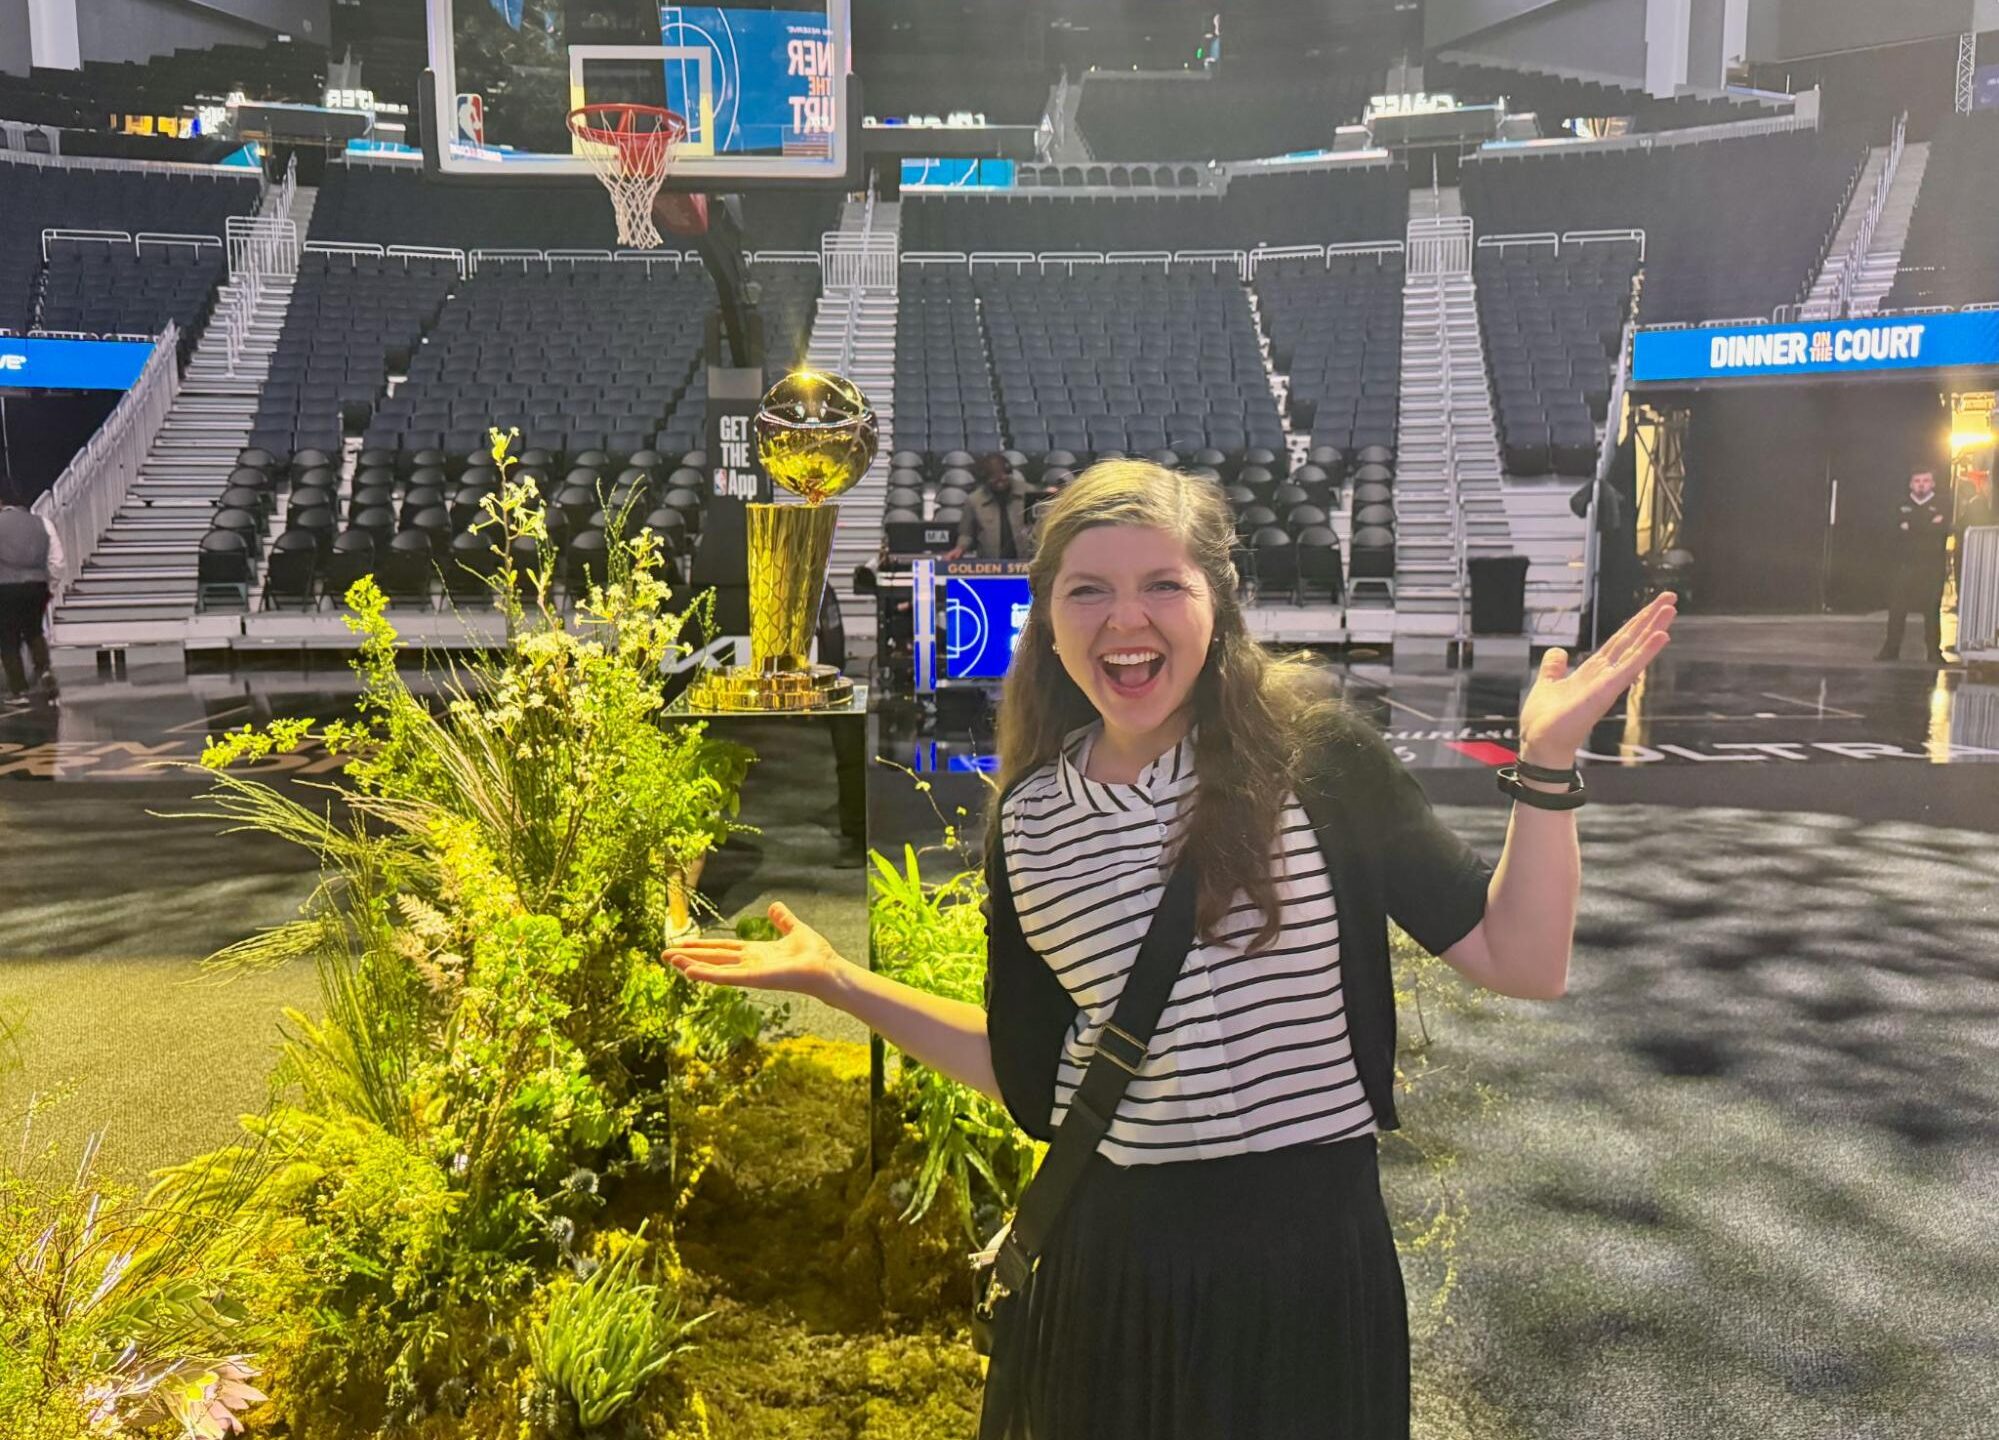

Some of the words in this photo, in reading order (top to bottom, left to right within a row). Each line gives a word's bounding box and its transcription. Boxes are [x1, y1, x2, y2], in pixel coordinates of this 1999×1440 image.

[1710, 332, 1808, 368] DINNER
[1835, 325, 1925, 362] COURT
[1812, 331, 1832, 347] ON
[1809, 347, 1833, 362] THE
[720, 415, 749, 441] GET
[720, 442, 750, 467] THE
[728, 469, 757, 500] App
[947, 562, 1002, 574] GOLDEN
